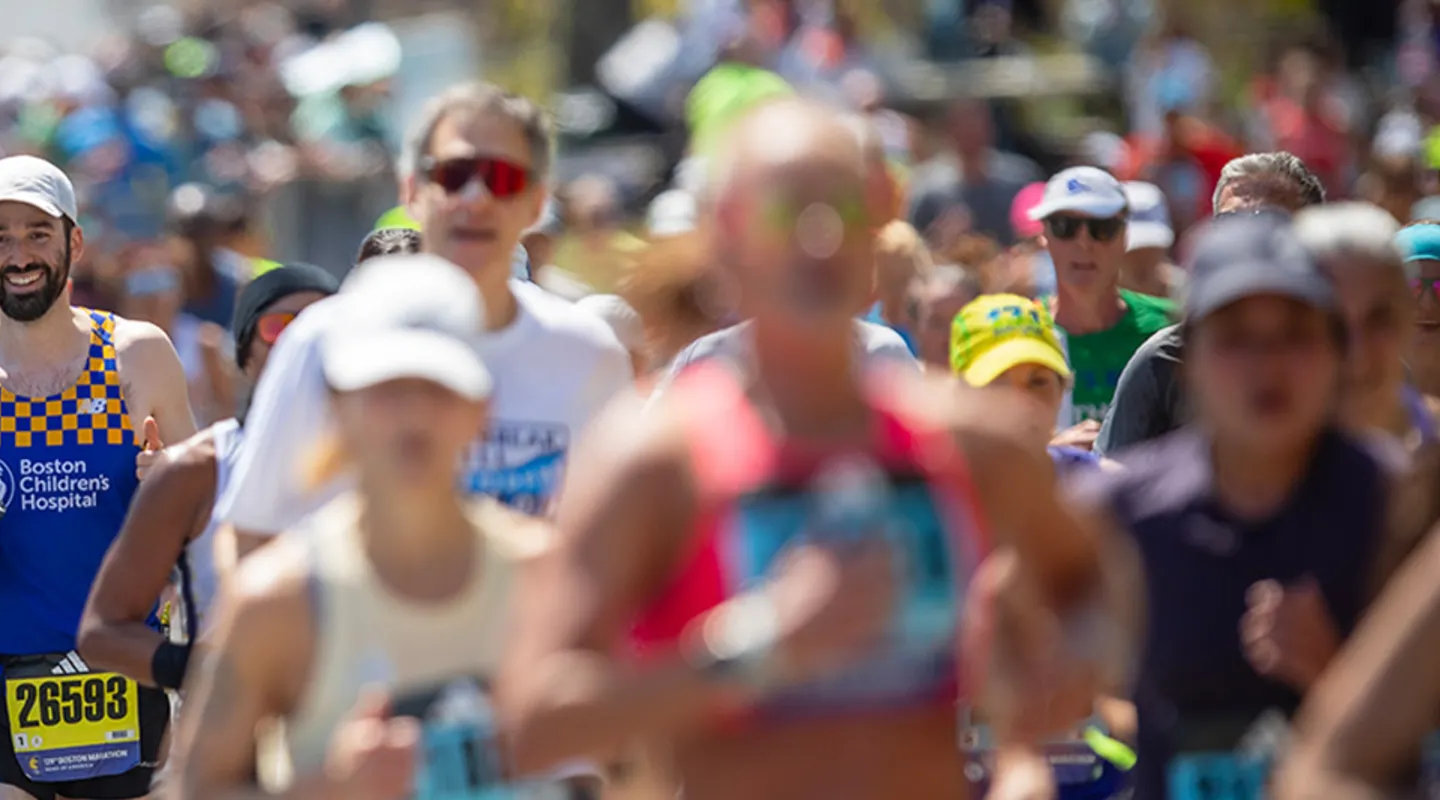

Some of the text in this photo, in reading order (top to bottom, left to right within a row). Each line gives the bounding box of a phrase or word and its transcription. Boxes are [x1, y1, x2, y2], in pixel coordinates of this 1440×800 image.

[19, 458, 86, 475] Boston
[19, 474, 110, 493] Children's
[21, 491, 98, 513] Hospital
[16, 676, 128, 728] 26593
